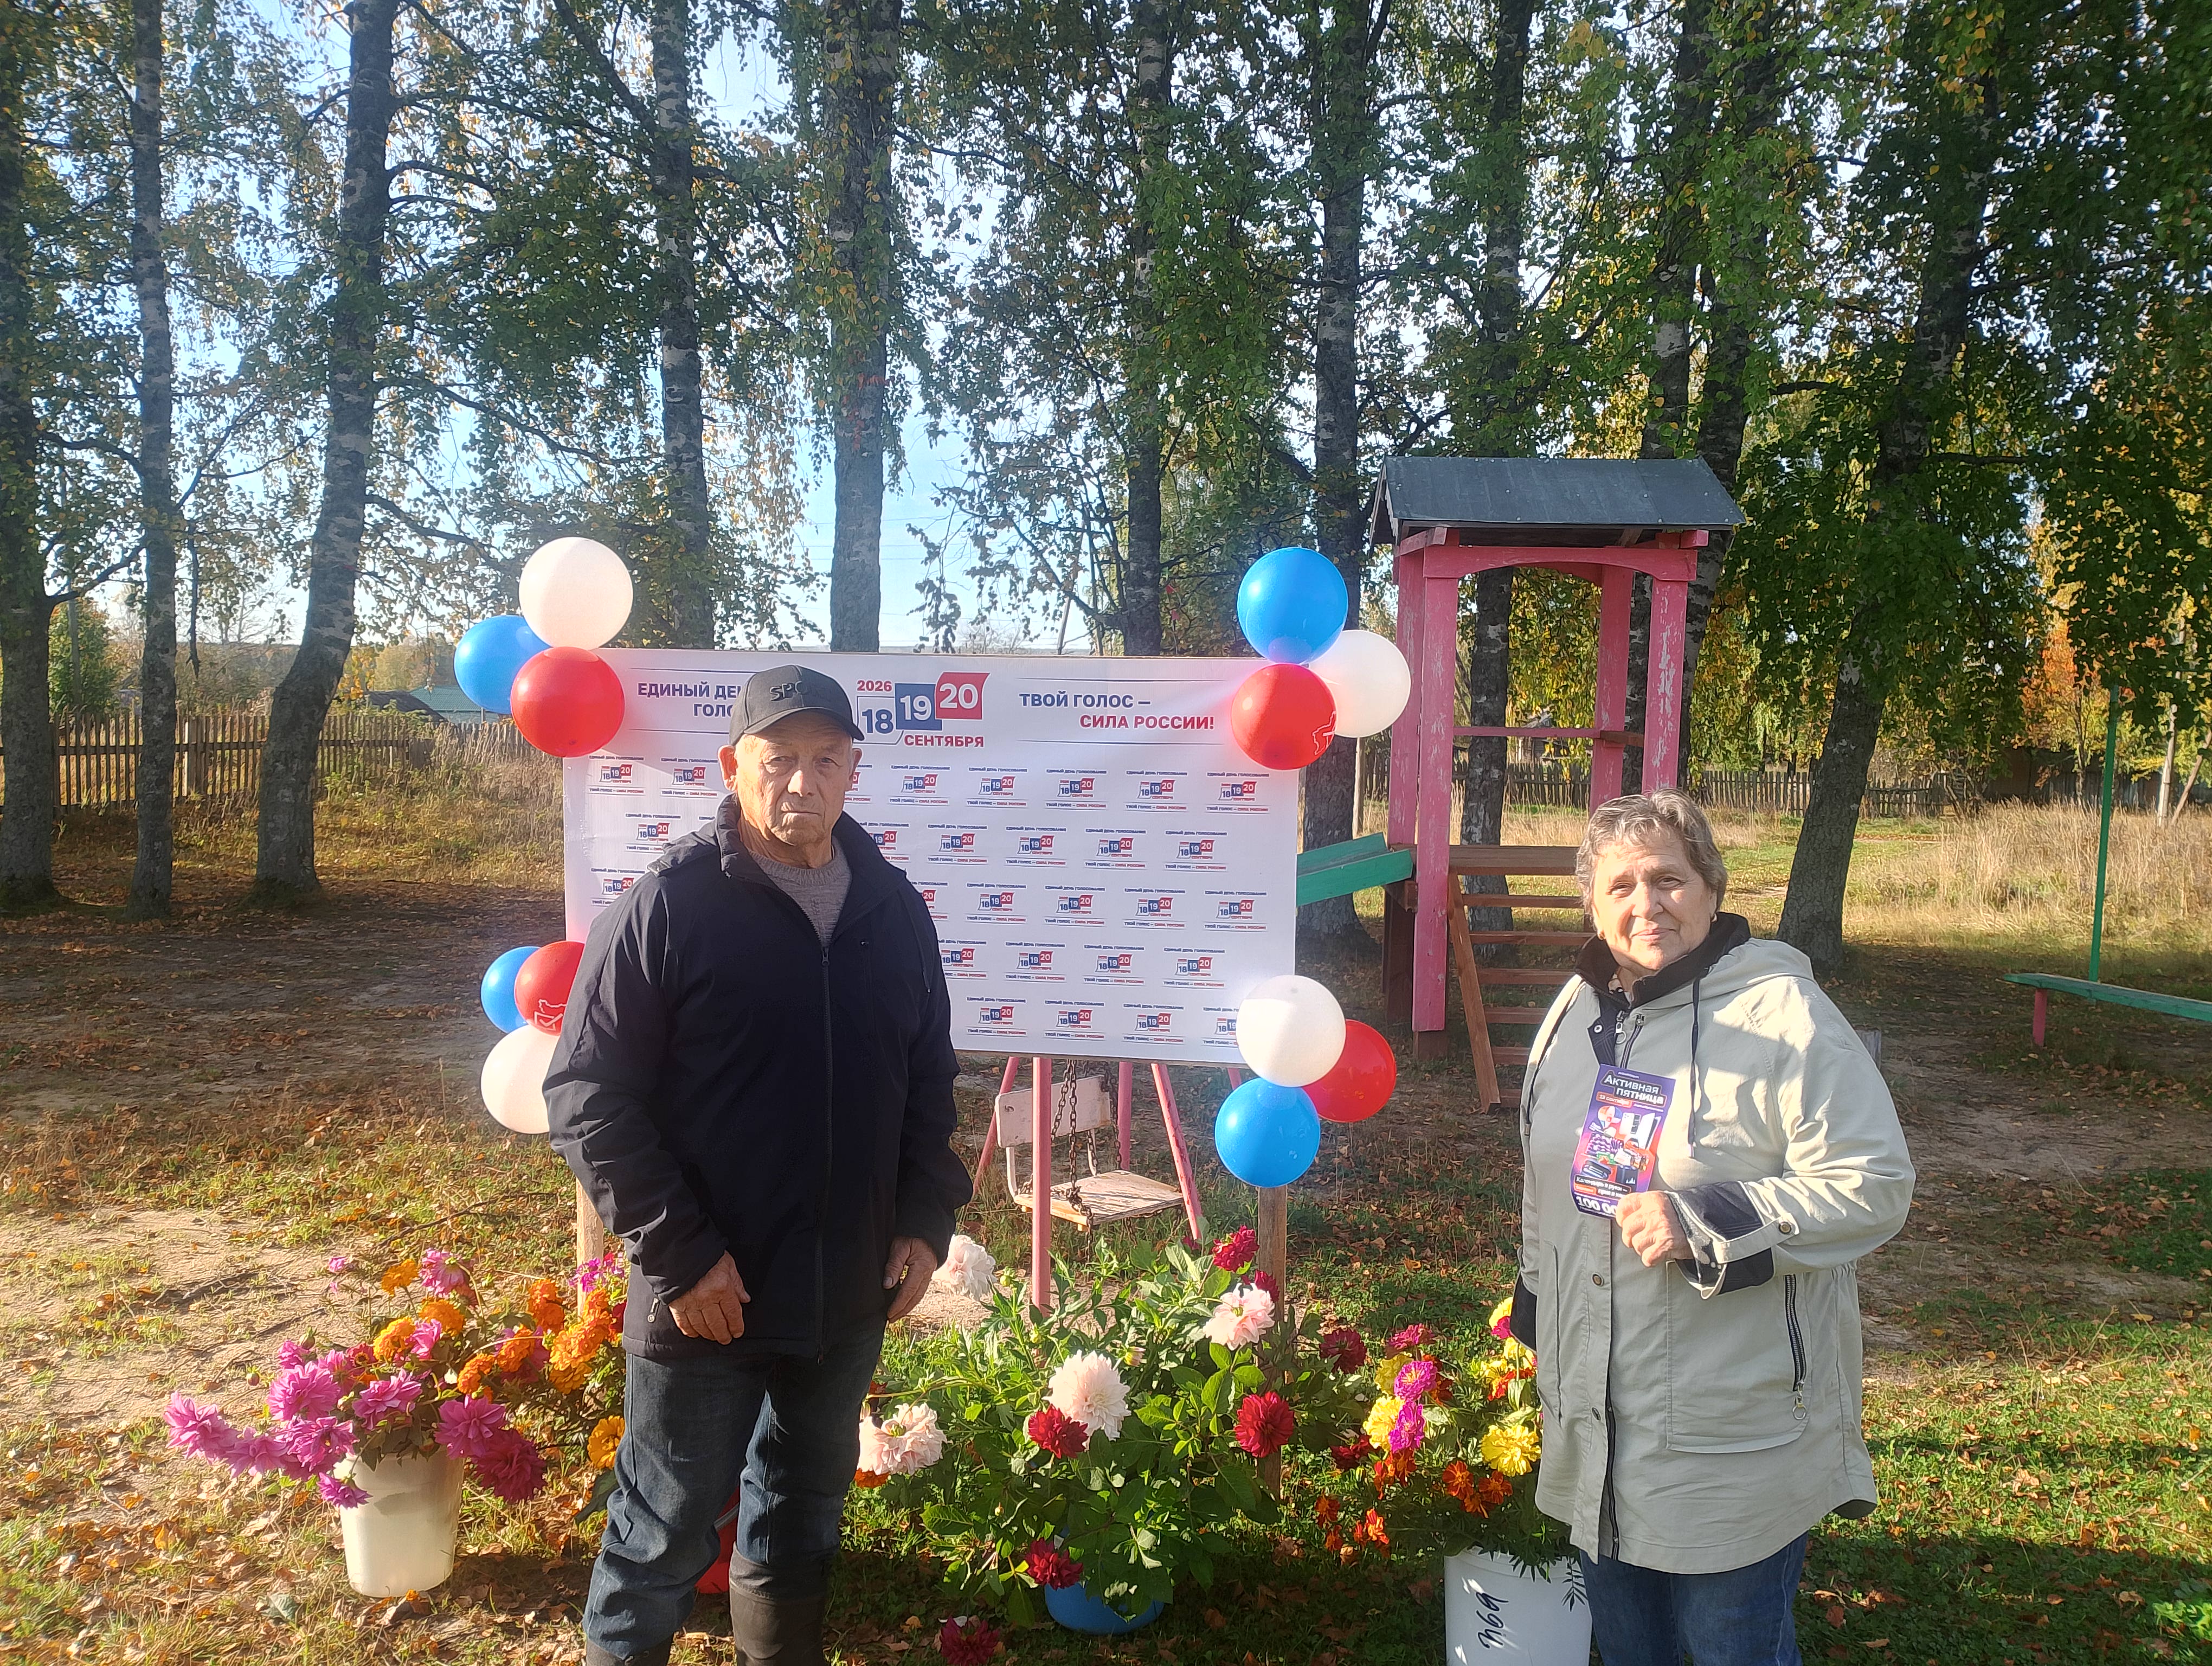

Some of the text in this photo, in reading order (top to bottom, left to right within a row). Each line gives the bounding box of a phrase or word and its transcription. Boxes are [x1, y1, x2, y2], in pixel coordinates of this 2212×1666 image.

[638, 681, 741, 700] ЕДИНЫЙ ДЕ
[857, 680, 892, 692] 2026
[1019, 690, 1068, 707] ТВОЙ
[1073, 694, 1134, 708] ГОЛОС
[861, 683, 979, 734] 18 19 20
[1079, 715, 1214, 729] СИЛА РОССИИ!
[904, 735, 985, 747] СЕНТЯБРЯ
[1604, 1074, 1659, 1094] Активная
[1616, 1087, 1664, 1105] пятница
[1576, 1196, 1601, 1211] 100
[1602, 1202, 1616, 1215] 00
